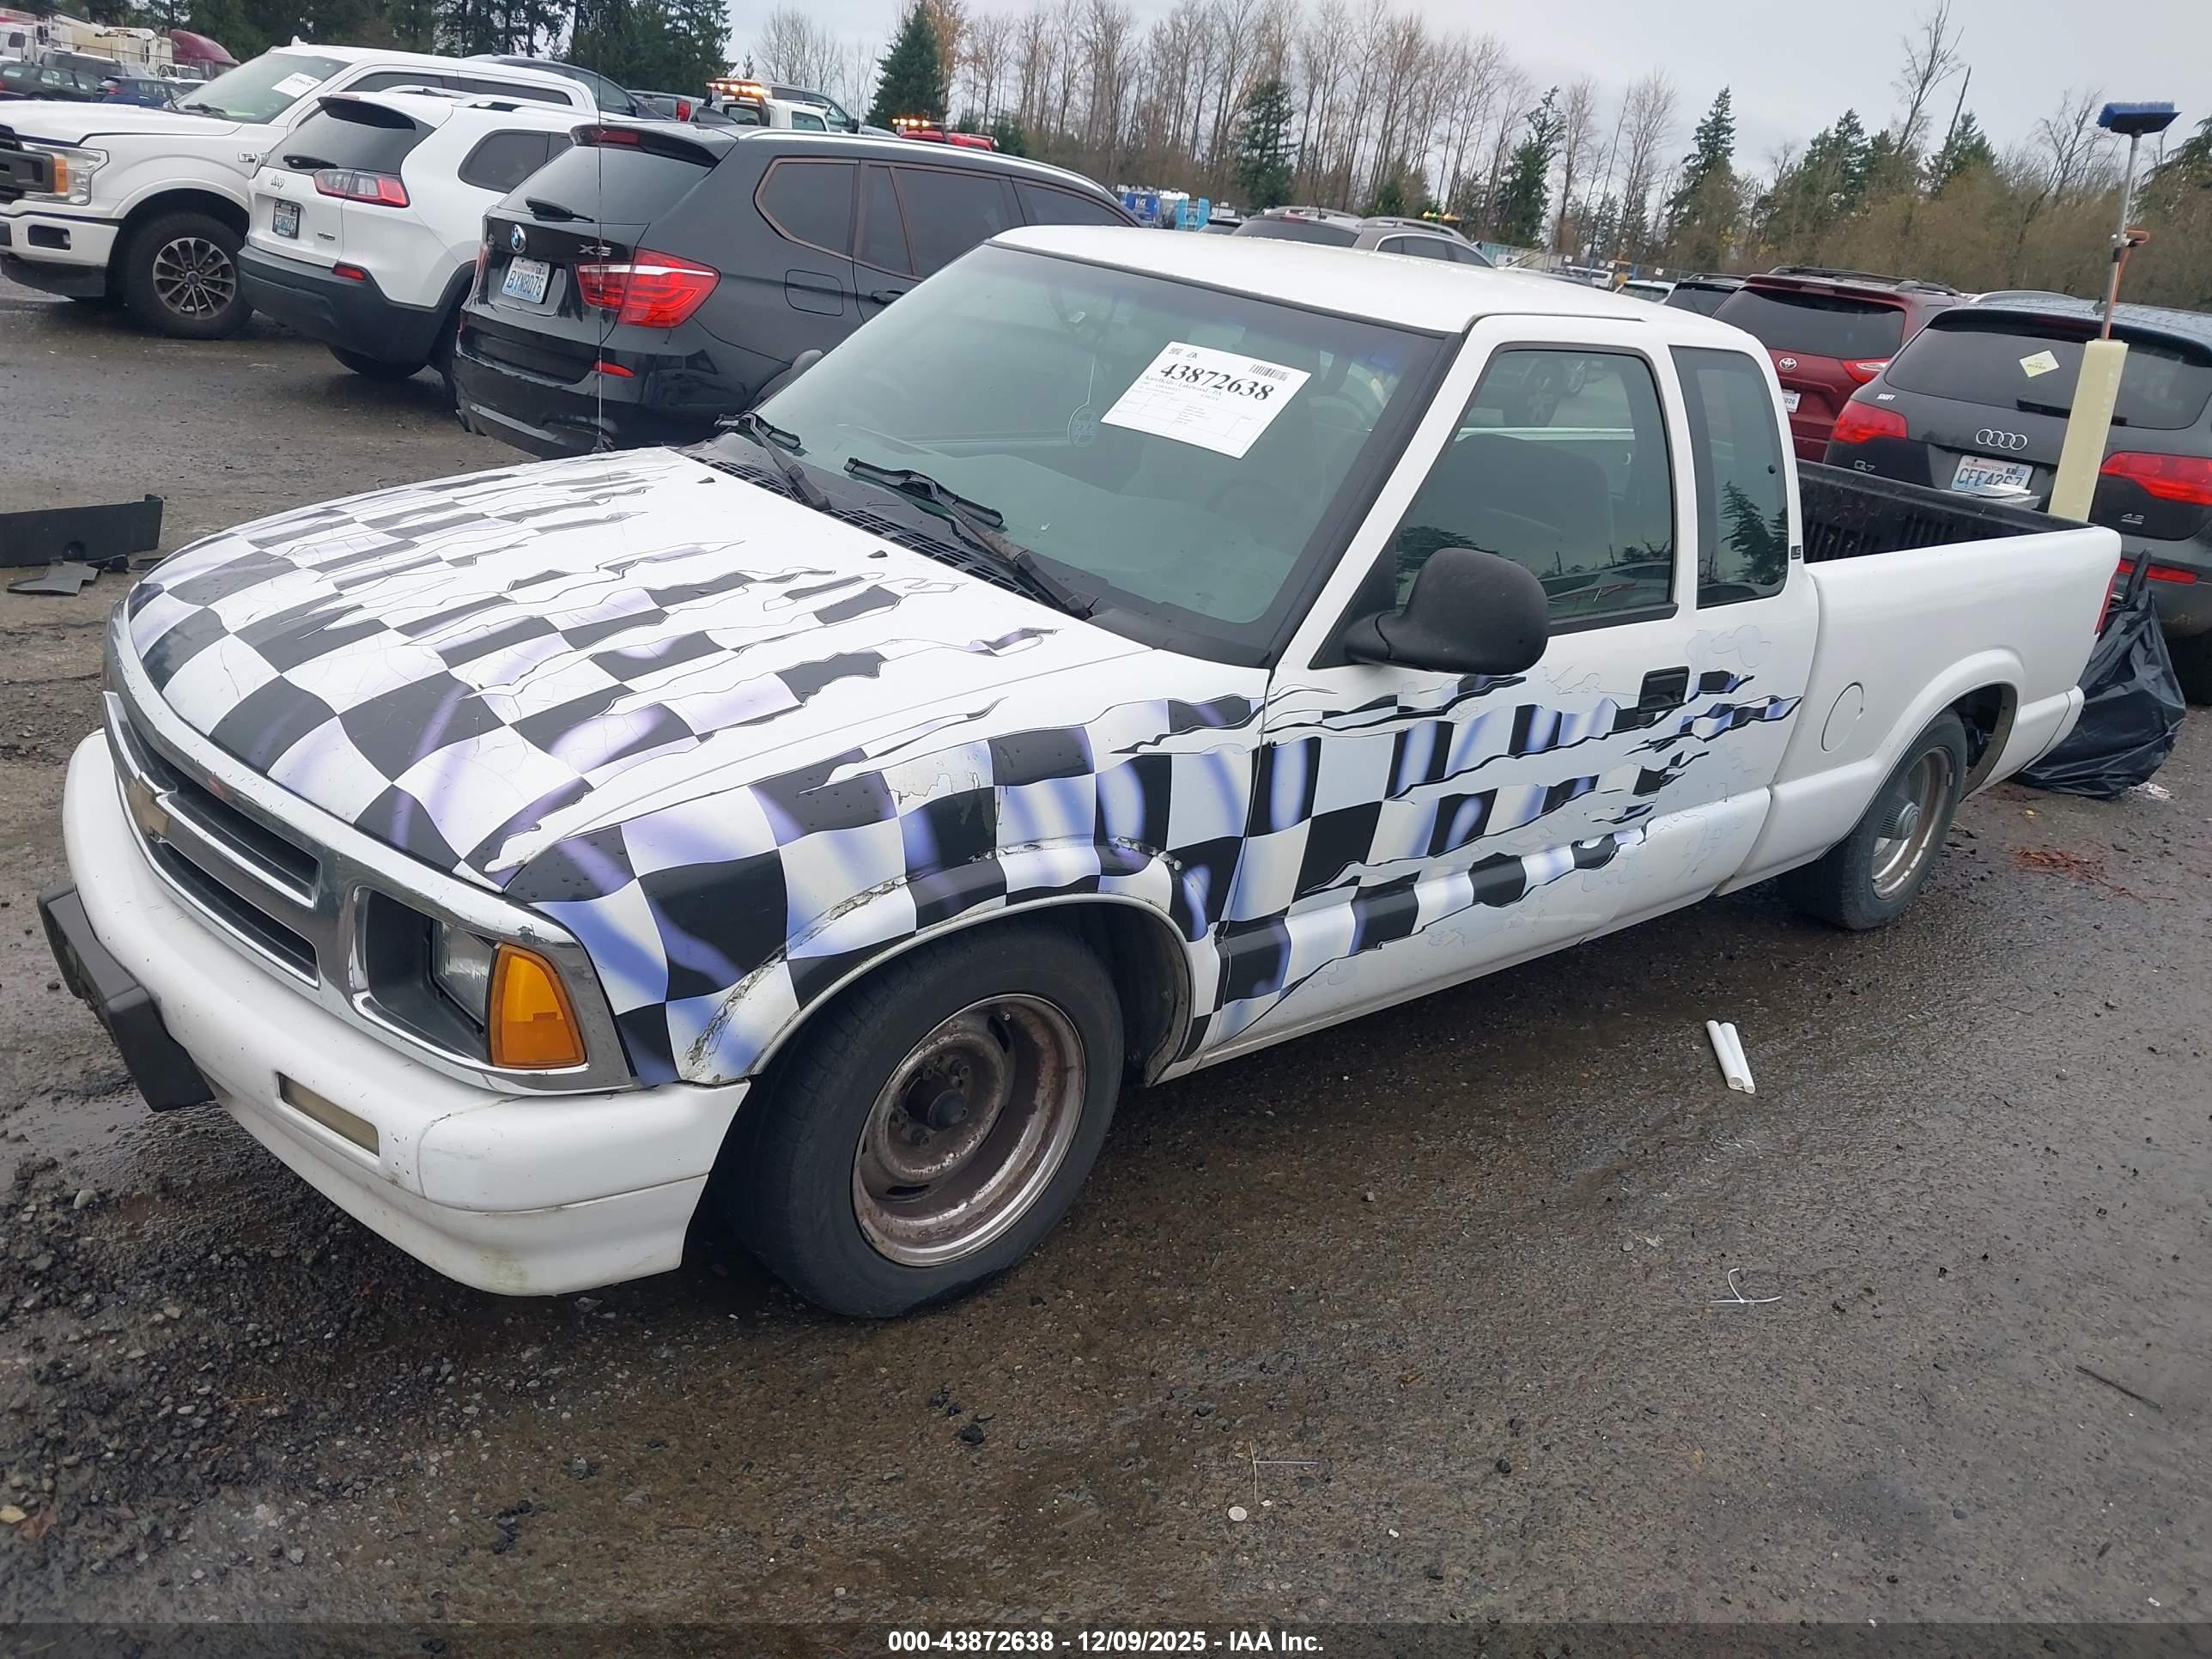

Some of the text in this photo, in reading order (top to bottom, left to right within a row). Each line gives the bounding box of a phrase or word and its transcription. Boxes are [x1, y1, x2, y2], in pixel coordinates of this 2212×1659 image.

[578, 244, 612, 256] X3
[507, 270, 544, 296] BYN8076
[1160, 363, 1274, 401] 43872638
[1854, 459, 1876, 471] Q7
